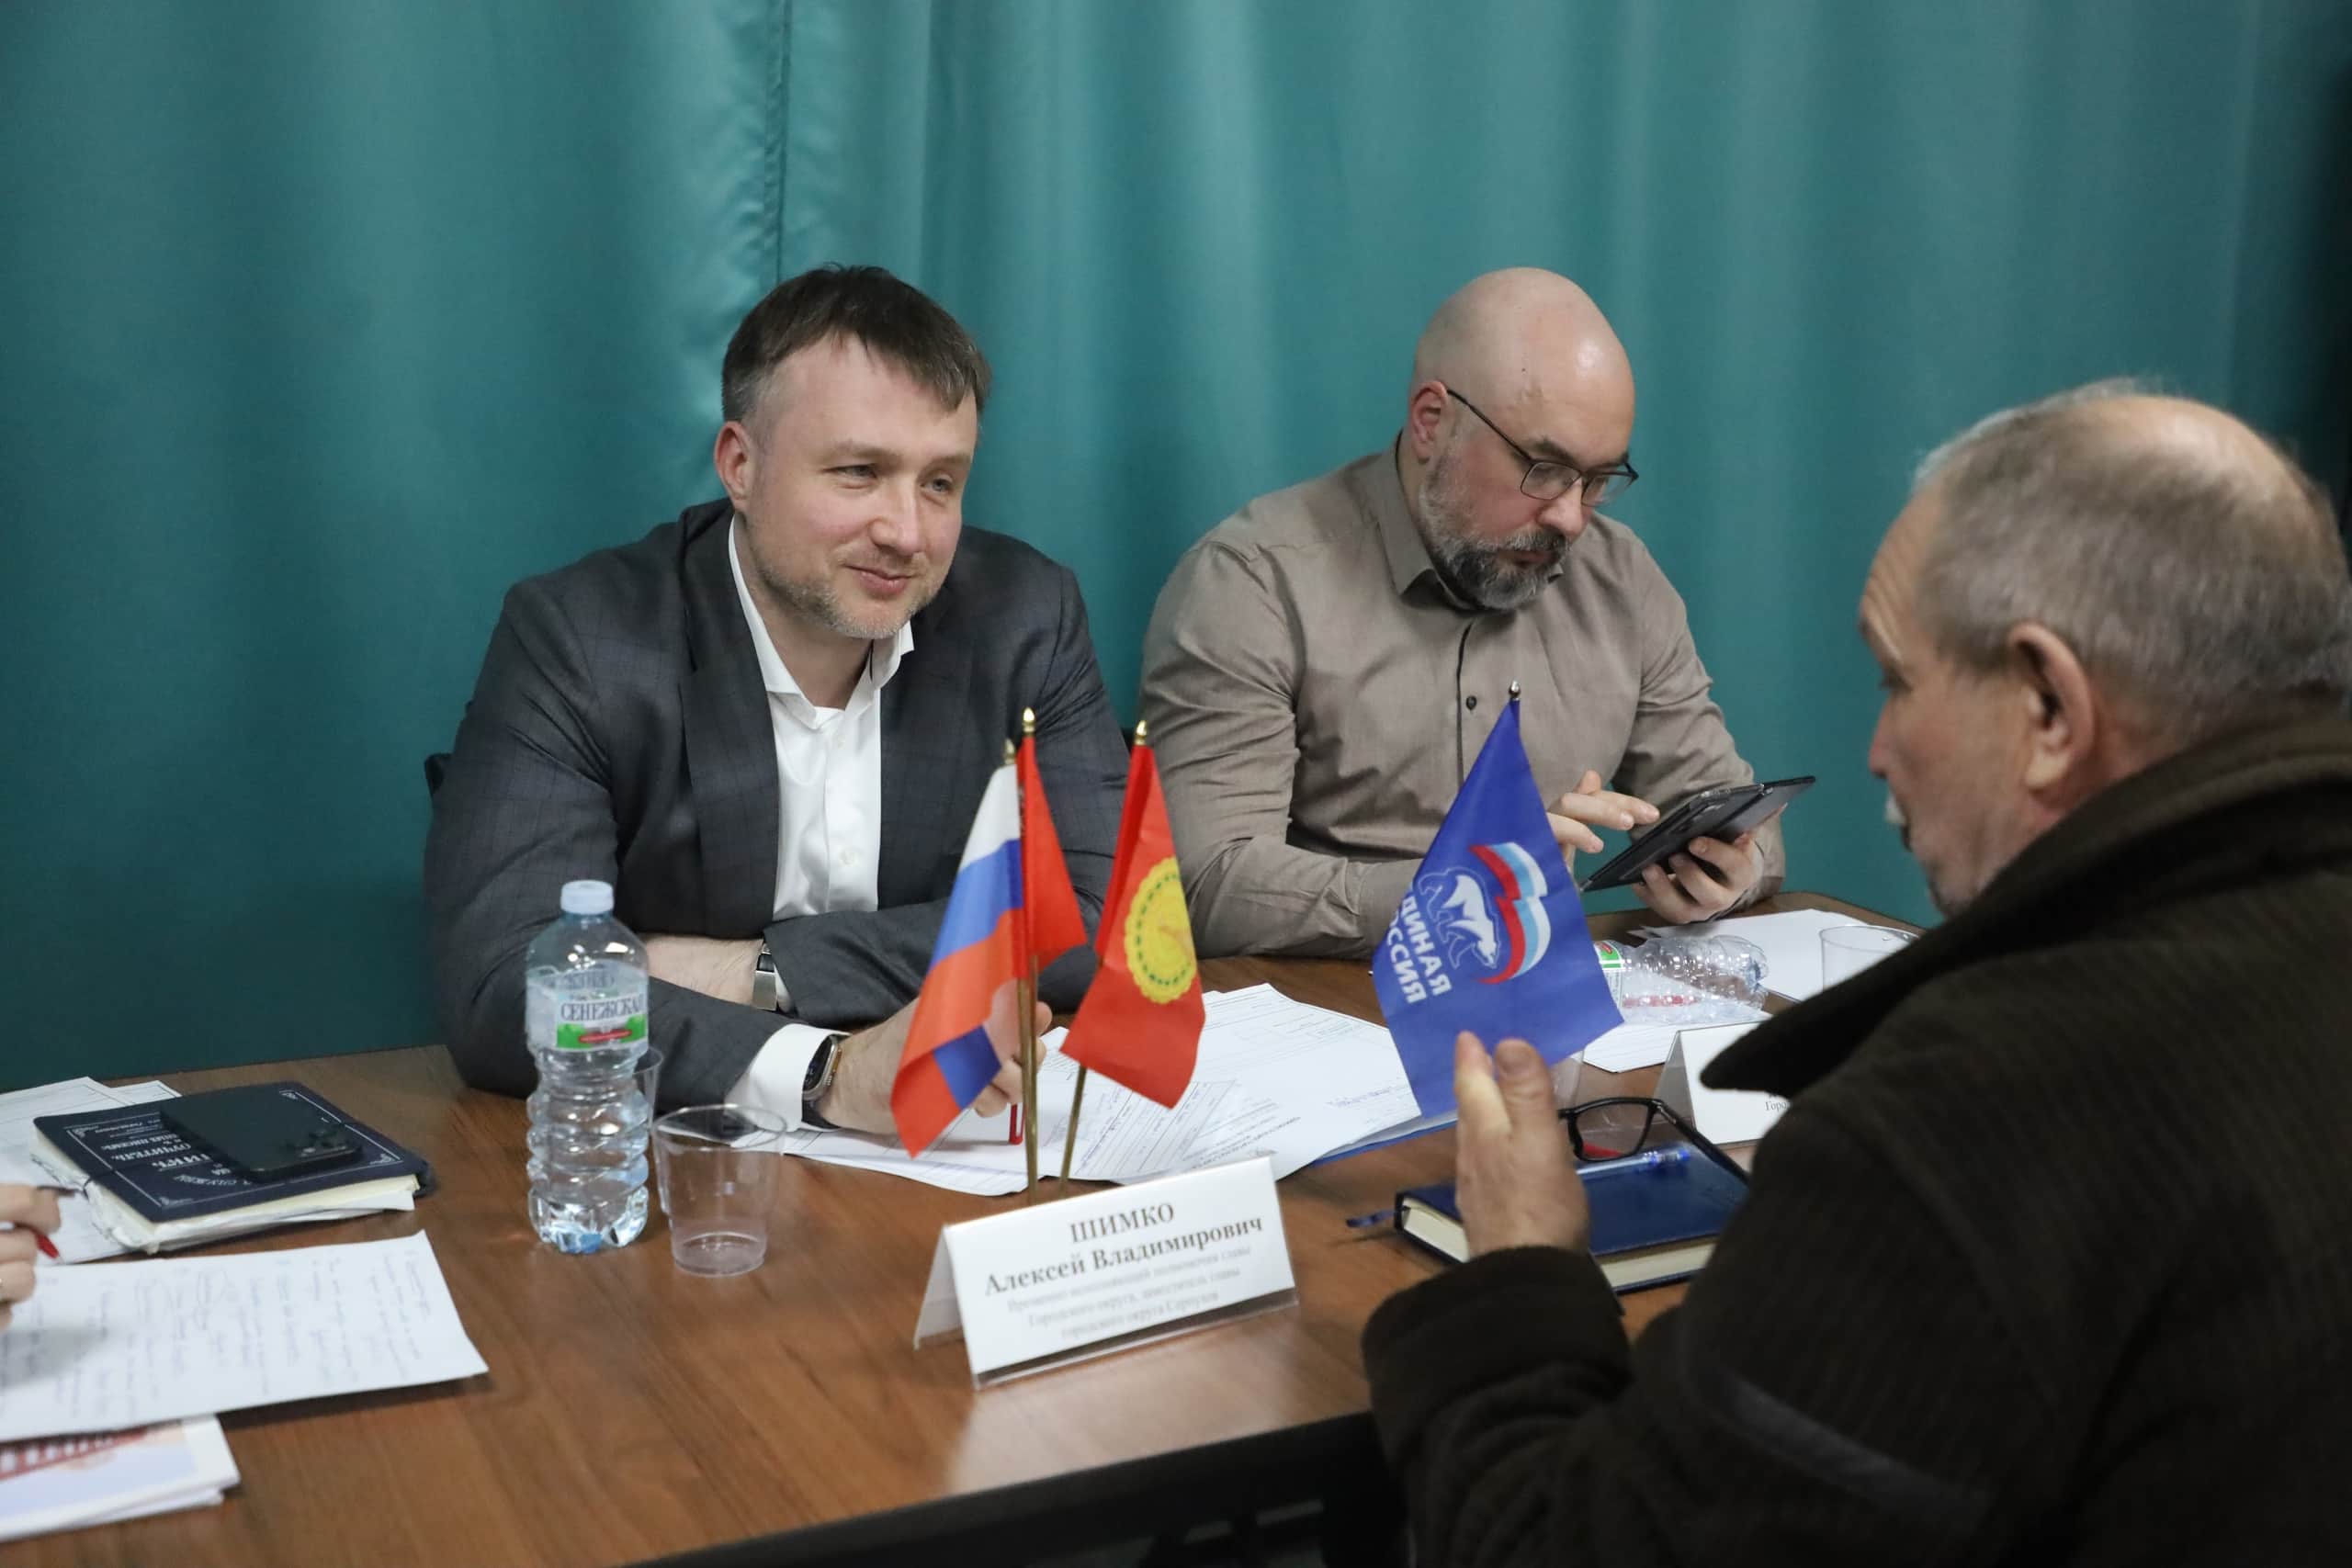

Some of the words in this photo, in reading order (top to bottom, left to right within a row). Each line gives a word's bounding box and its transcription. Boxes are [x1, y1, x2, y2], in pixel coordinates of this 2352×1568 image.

[1386, 910, 1427, 1003] ССИЯ
[1401, 896, 1453, 996] ДИНАЯ
[984, 1251, 1086, 1296] Алексей
[1091, 1216, 1263, 1272] Владимирович
[1069, 1201, 1175, 1244] ШИМКО
